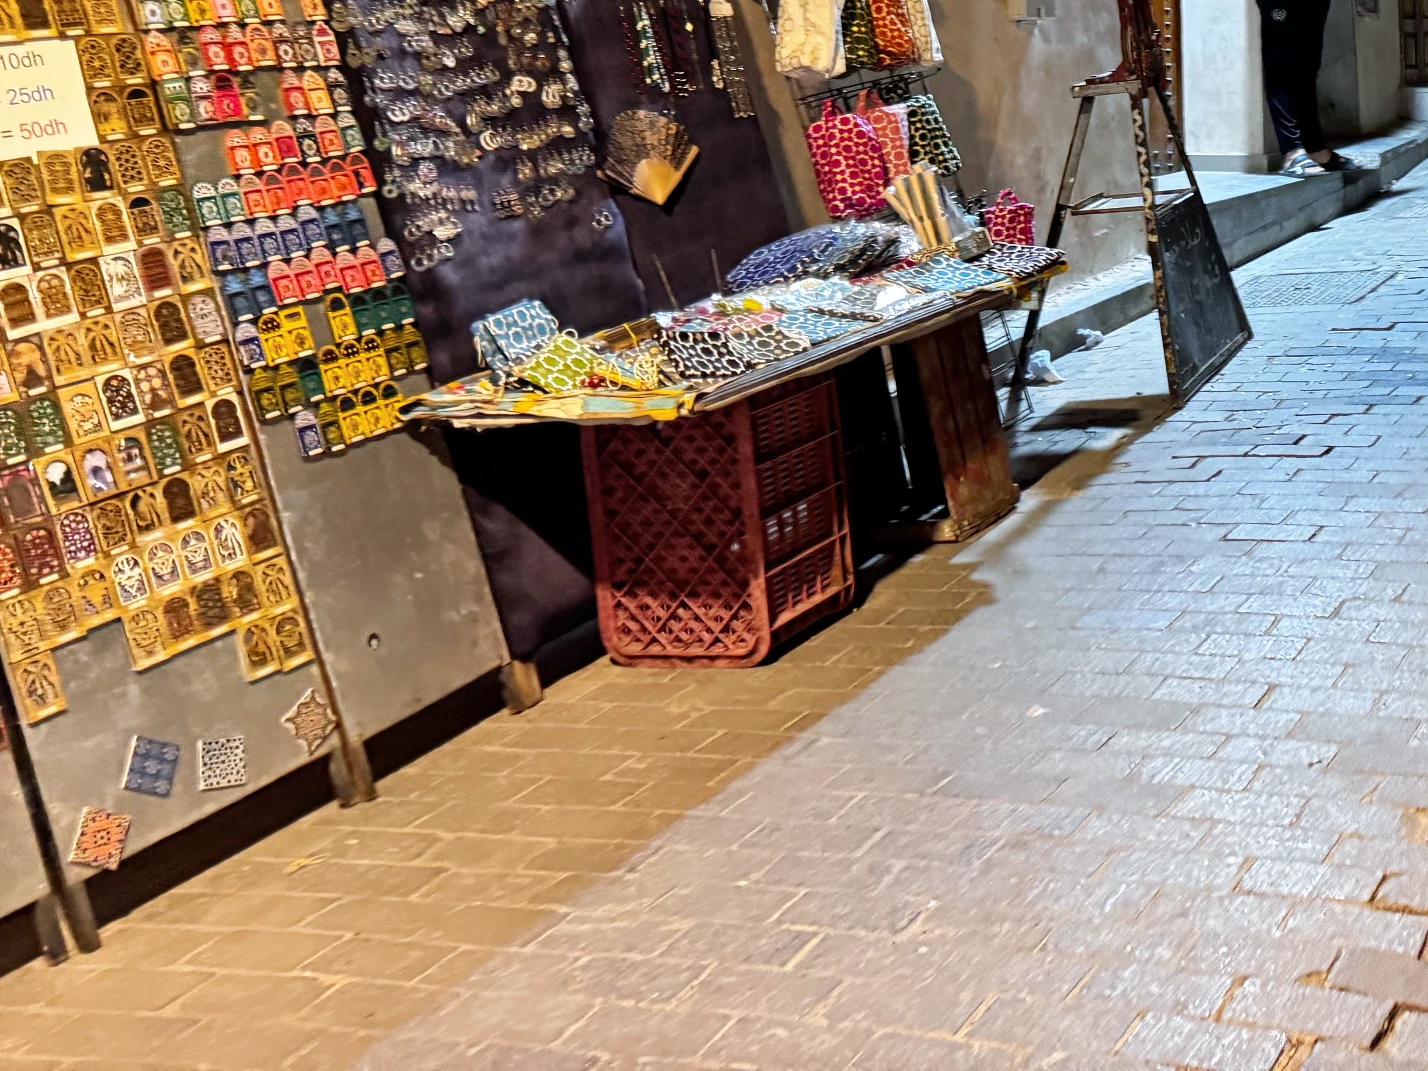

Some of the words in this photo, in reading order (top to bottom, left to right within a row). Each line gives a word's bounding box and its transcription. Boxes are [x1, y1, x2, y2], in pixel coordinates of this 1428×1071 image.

[0, 51, 45, 70] 10dh
[6, 84, 55, 106] 25dh
[19, 118, 68, 140] 50dh
